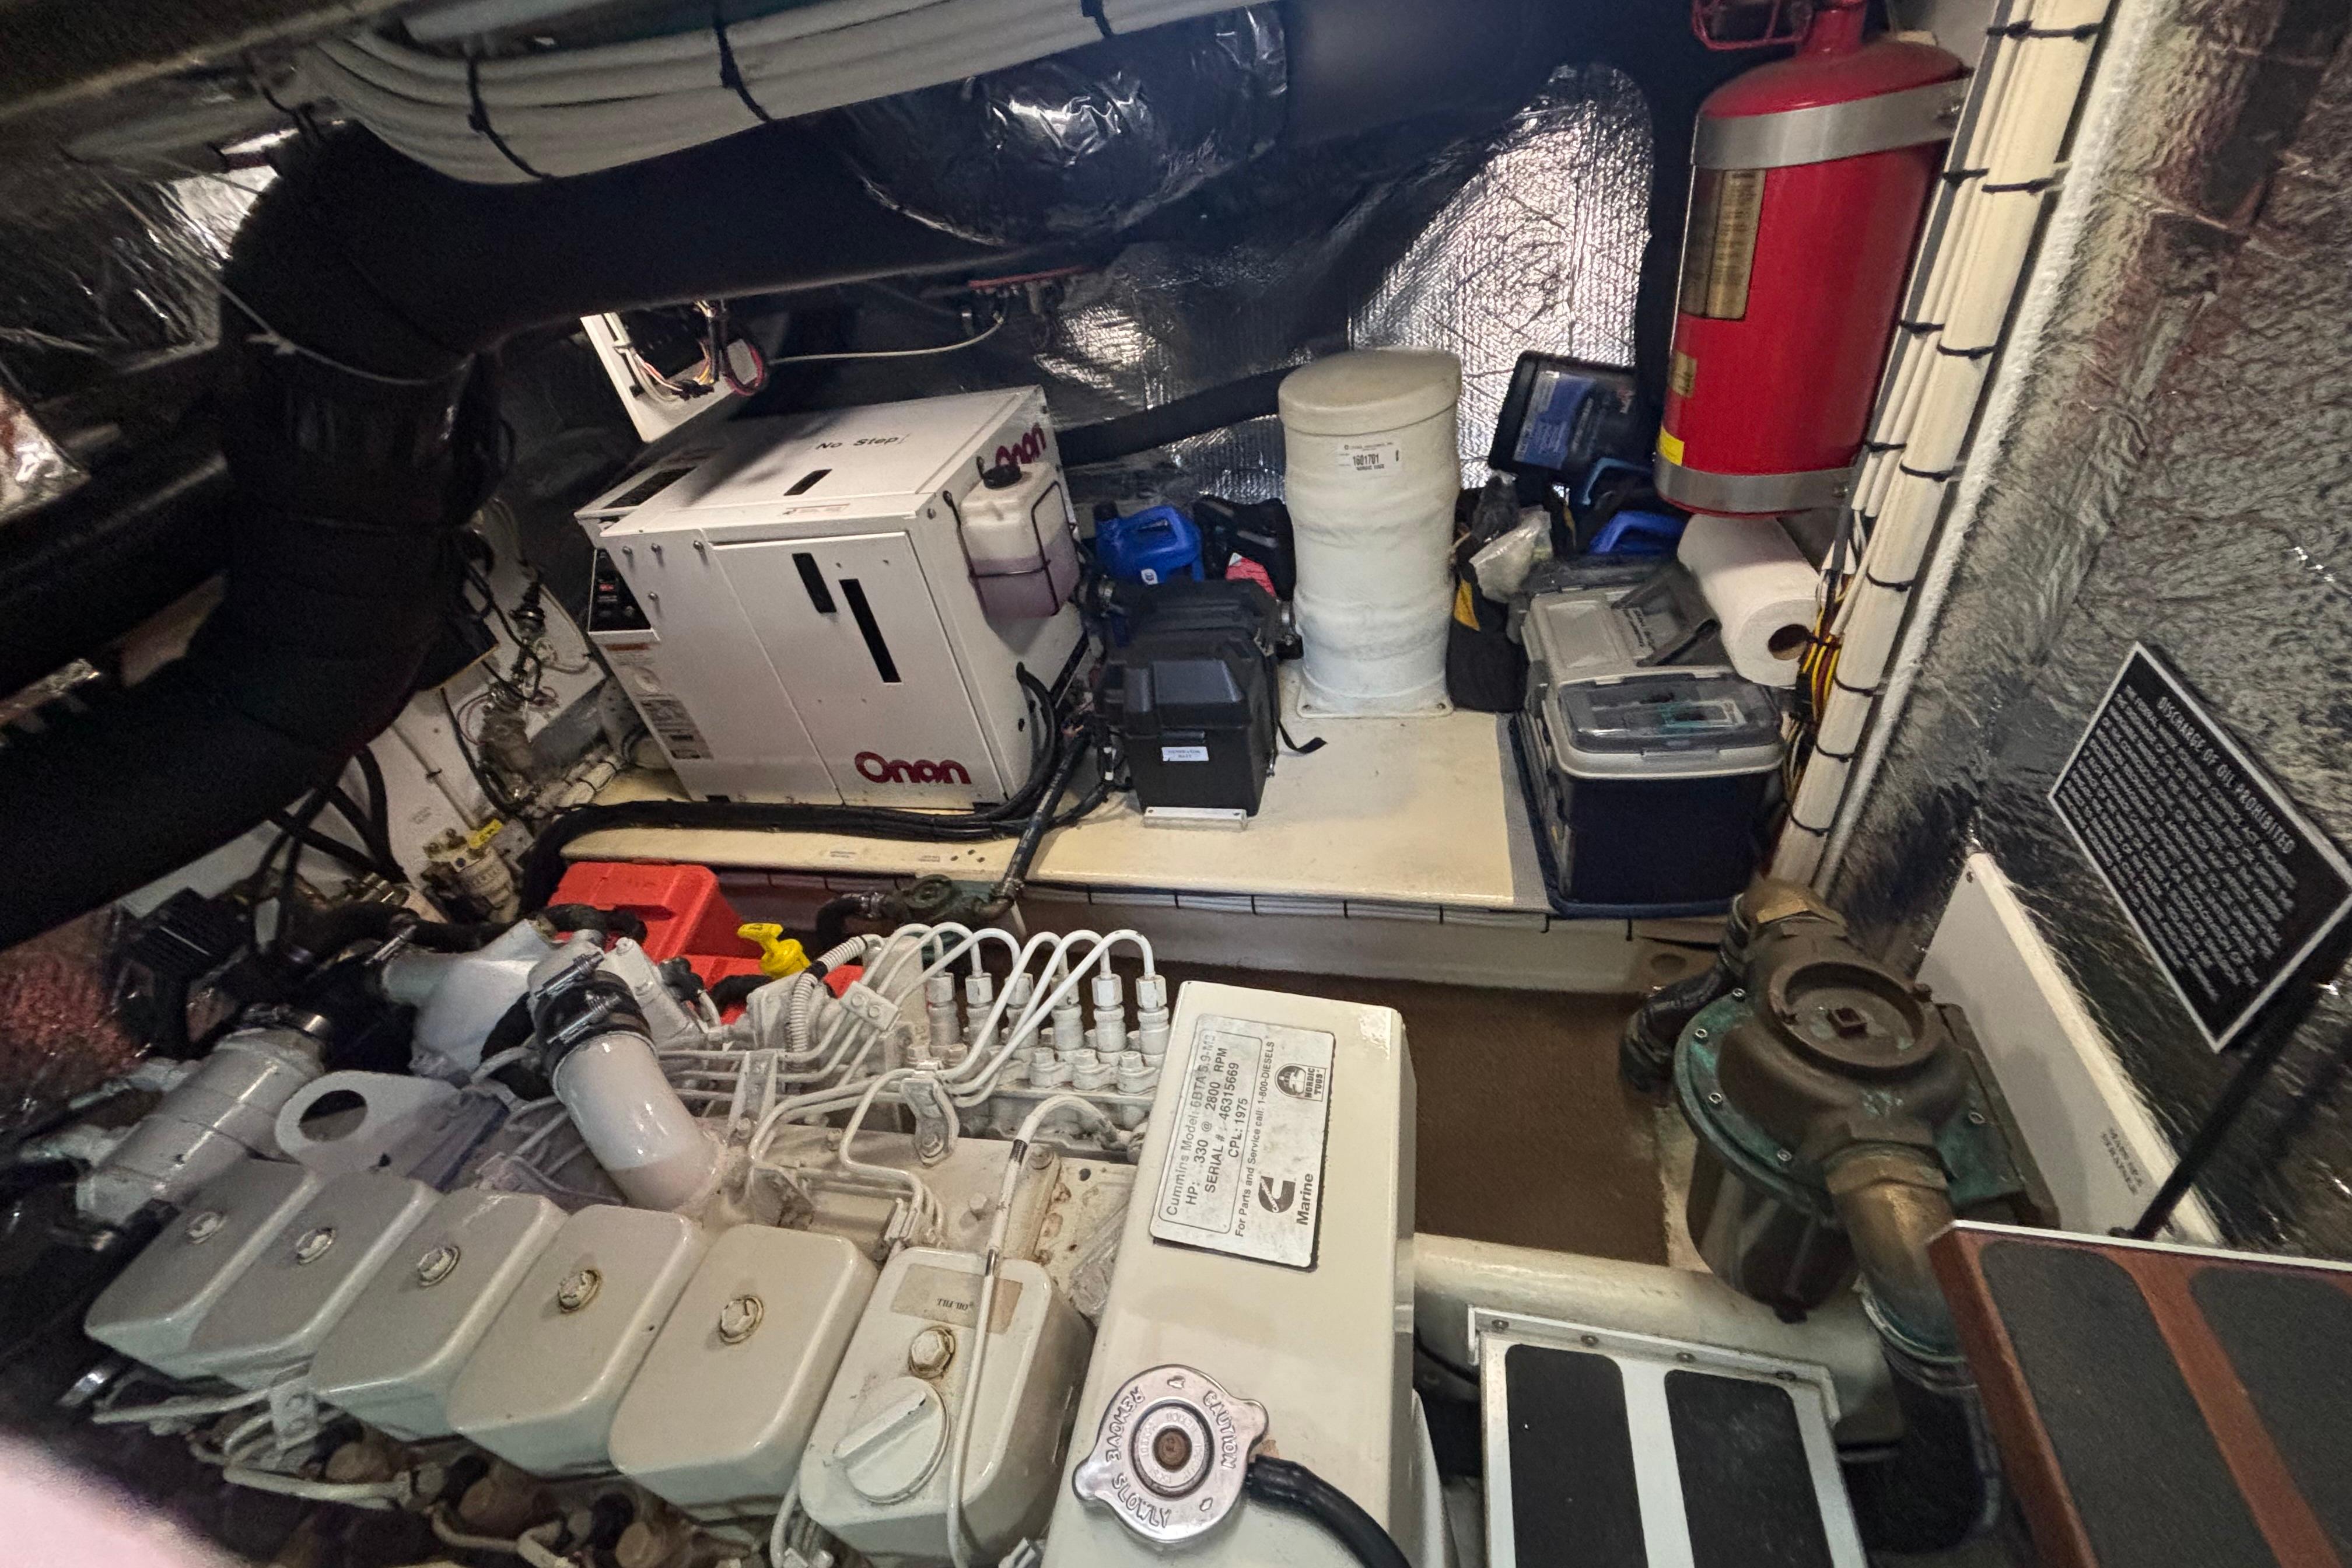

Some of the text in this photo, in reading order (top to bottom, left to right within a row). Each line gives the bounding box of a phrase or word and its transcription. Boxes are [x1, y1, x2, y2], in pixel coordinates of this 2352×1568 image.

[815, 436, 899, 450] No Step
[855, 751, 972, 784] Onan
[2158, 697, 2295, 854] DISCHARGE OF OIL PROHIBITED
[1258, 1042, 1274, 1104] 1-800-DIESELS
[1304, 1068, 1315, 1098] NORDIC
[1314, 1074, 1322, 1094] TUGS
[1166, 1156, 1189, 1215] Cummins
[1190, 1075, 1206, 1107] 6BTA
[1185, 1048, 1227, 1205] HP: 330 @ 2800 RPM
[1205, 1146, 1223, 1193] SERIAL
[1219, 1063, 1239, 1120] 46315669
[1228, 1098, 1248, 1157] CPL: 1975
[1247, 1129, 1260, 1164] Service
[1239, 1189, 1251, 1215] Parts
[1245, 1167, 1254, 1186] and
[1297, 1174, 1313, 1225] Marine
[1235, 1219, 1245, 1237] For
[937, 1298, 969, 1311] OIL FILL
[1106, 1386, 1145, 1462] REMOVE
[1203, 1390, 1238, 1470] CAUTION
[1112, 1472, 1171, 1528] SLOWLY
